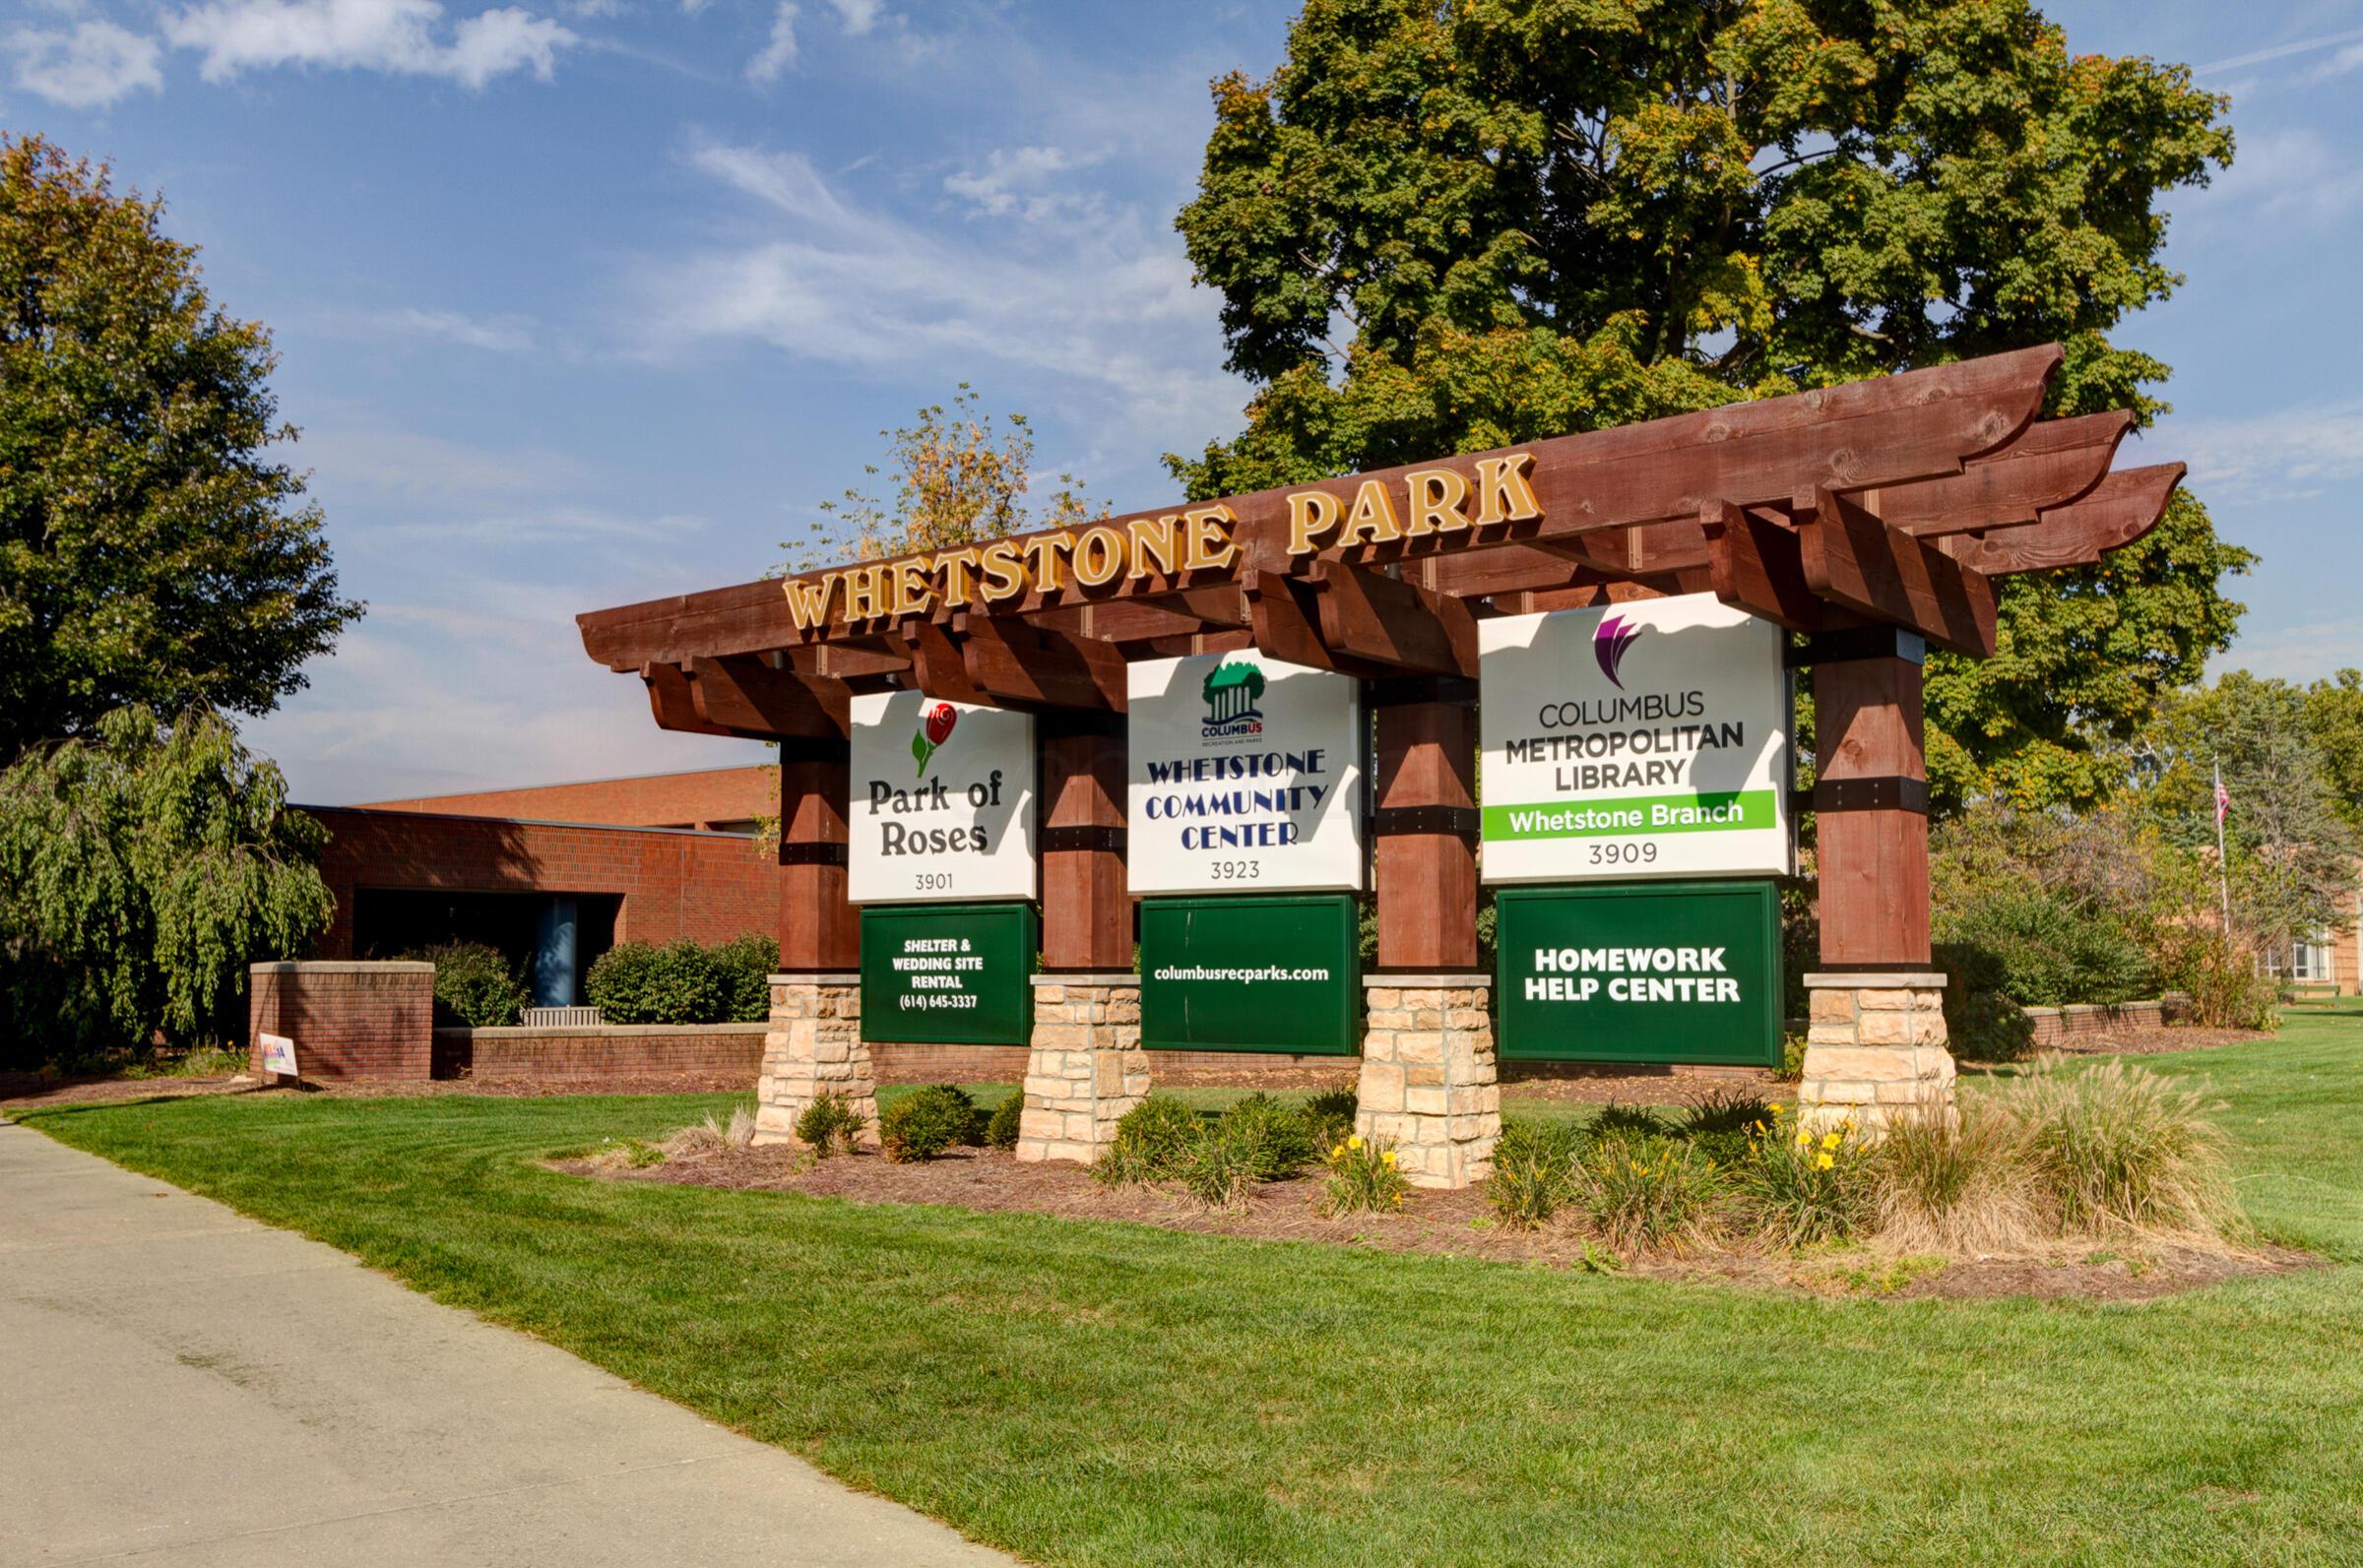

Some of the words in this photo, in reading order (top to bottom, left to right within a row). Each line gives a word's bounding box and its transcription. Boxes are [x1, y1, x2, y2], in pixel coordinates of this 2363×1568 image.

[783, 503, 1244, 631] WHETSTONE
[1286, 452, 1545, 555] PARK
[1538, 690, 1704, 729] COLUMBUS
[1201, 722, 1262, 737] COLUMBUS
[1505, 721, 1744, 765] METROPOLITAN
[1147, 749, 1325, 785] WHETSTONE
[1556, 758, 1687, 791] LIBRARY
[868, 775, 950, 815] Park
[967, 769, 1002, 808] of
[1145, 784, 1329, 820] COMMUNITY
[1509, 808, 1643, 834] Whetstone
[1651, 799, 1744, 827] Branch
[881, 821, 988, 856] Roses
[1182, 821, 1299, 850] CENTER
[1588, 843, 1658, 865] 3909
[915, 873, 953, 890] 3901
[1211, 860, 1260, 880] 3923
[904, 939, 957, 953] SHELTER
[960, 938, 971, 952] &
[892, 957, 952, 971] WEDDING
[954, 957, 983, 971] SITE
[1535, 947, 1727, 972] HOMEWORK
[912, 975, 963, 989] RENTAL
[1154, 965, 1329, 984] columbusrecparks.com
[1524, 977, 1600, 1001] HELP
[1608, 977, 1741, 1002] CENTER
[900, 994, 926, 1011] (614)
[928, 994, 978, 1009] 645-3337
